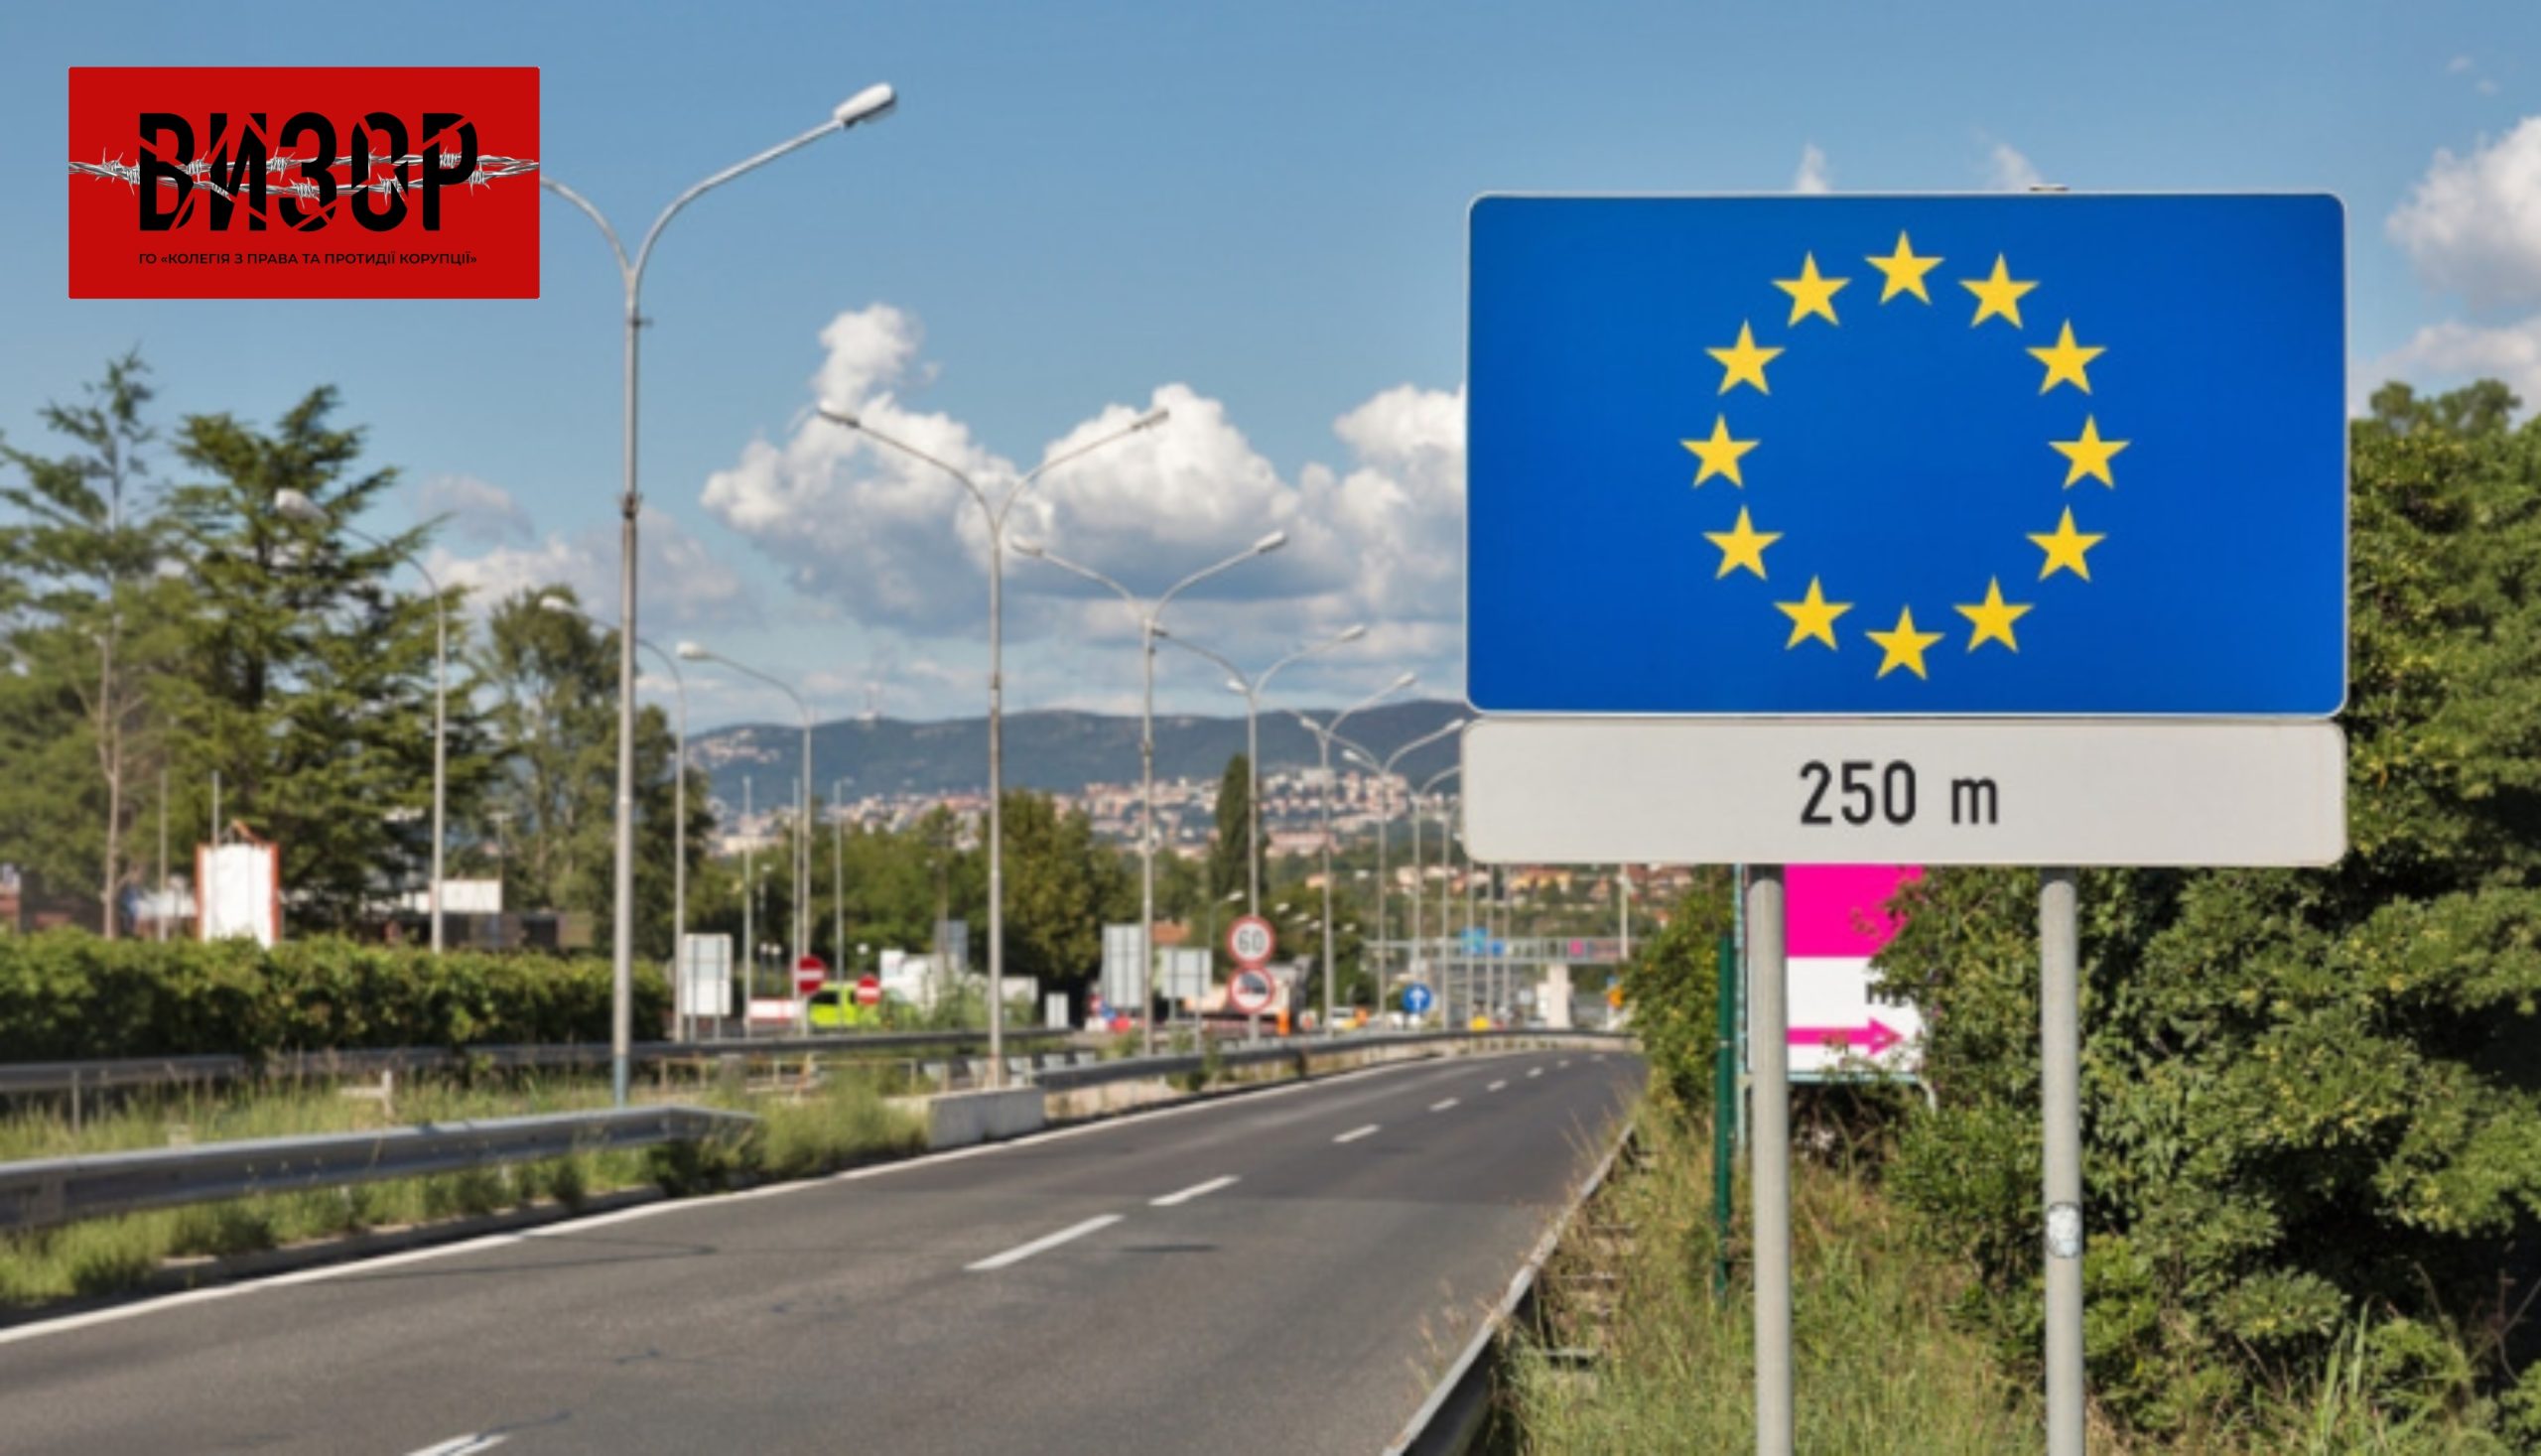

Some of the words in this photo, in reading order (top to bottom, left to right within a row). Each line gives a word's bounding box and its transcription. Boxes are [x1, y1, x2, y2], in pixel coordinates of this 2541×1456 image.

[1800, 760, 1917, 826] 250
[1950, 777, 1998, 825] m
[1238, 929, 1266, 953] 60
